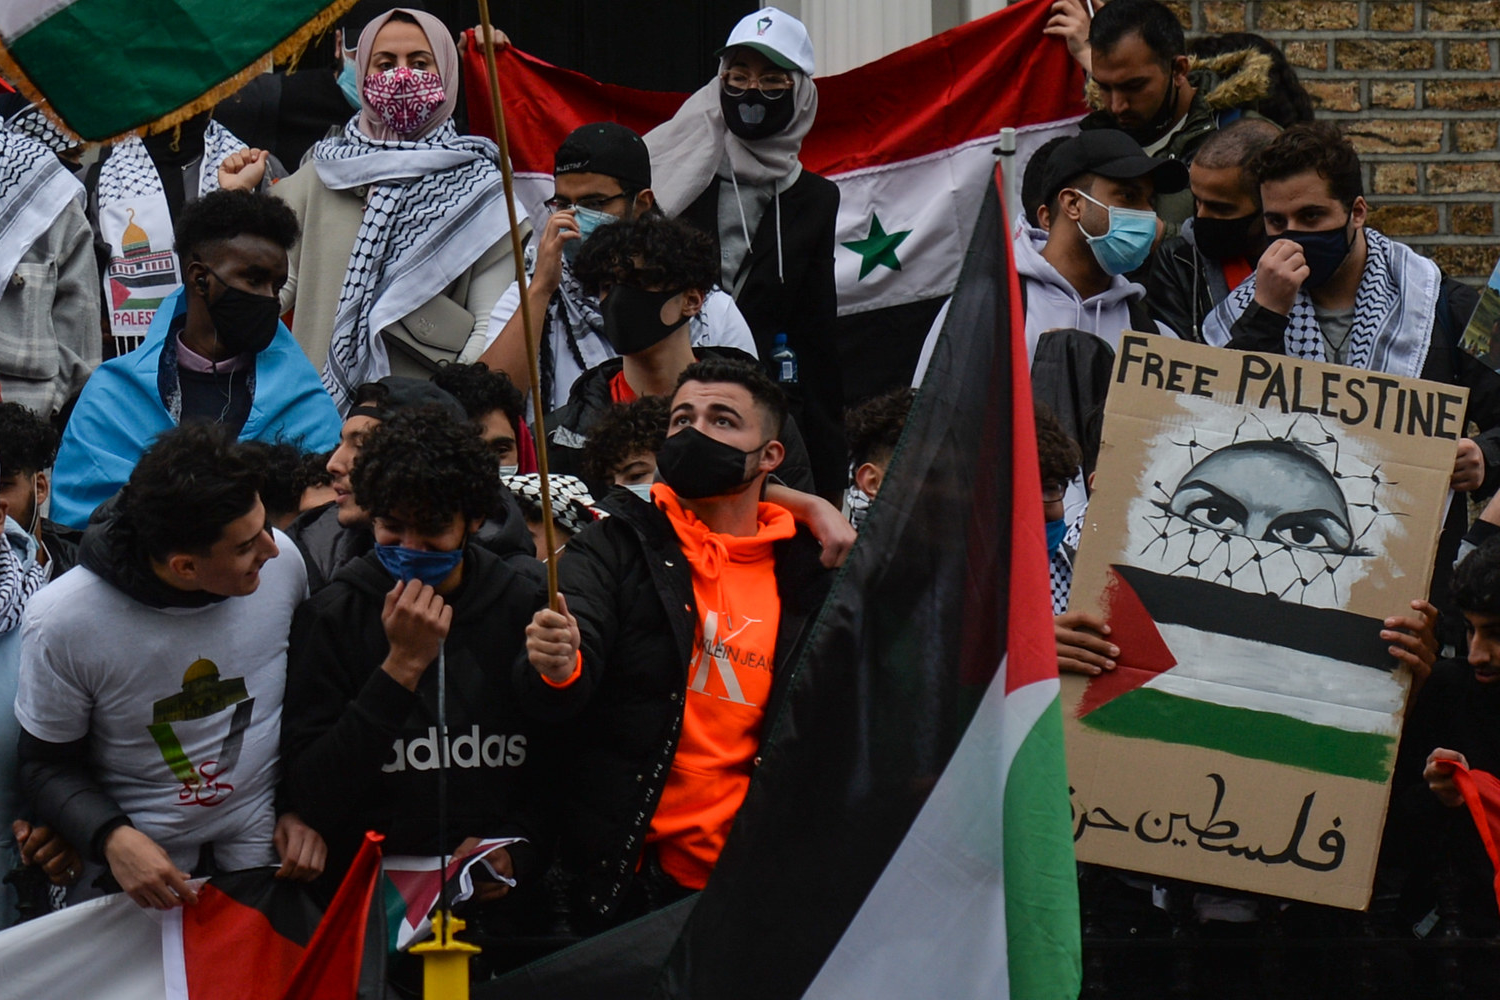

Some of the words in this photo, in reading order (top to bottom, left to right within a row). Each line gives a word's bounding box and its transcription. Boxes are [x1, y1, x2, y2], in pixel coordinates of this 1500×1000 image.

[1116, 336, 1219, 399] FREE
[1235, 354, 1463, 441] PALESTINE
[741, 651, 775, 673] JEAN
[381, 724, 528, 774] adidas
[1135, 773, 1346, 871] فلسطين
